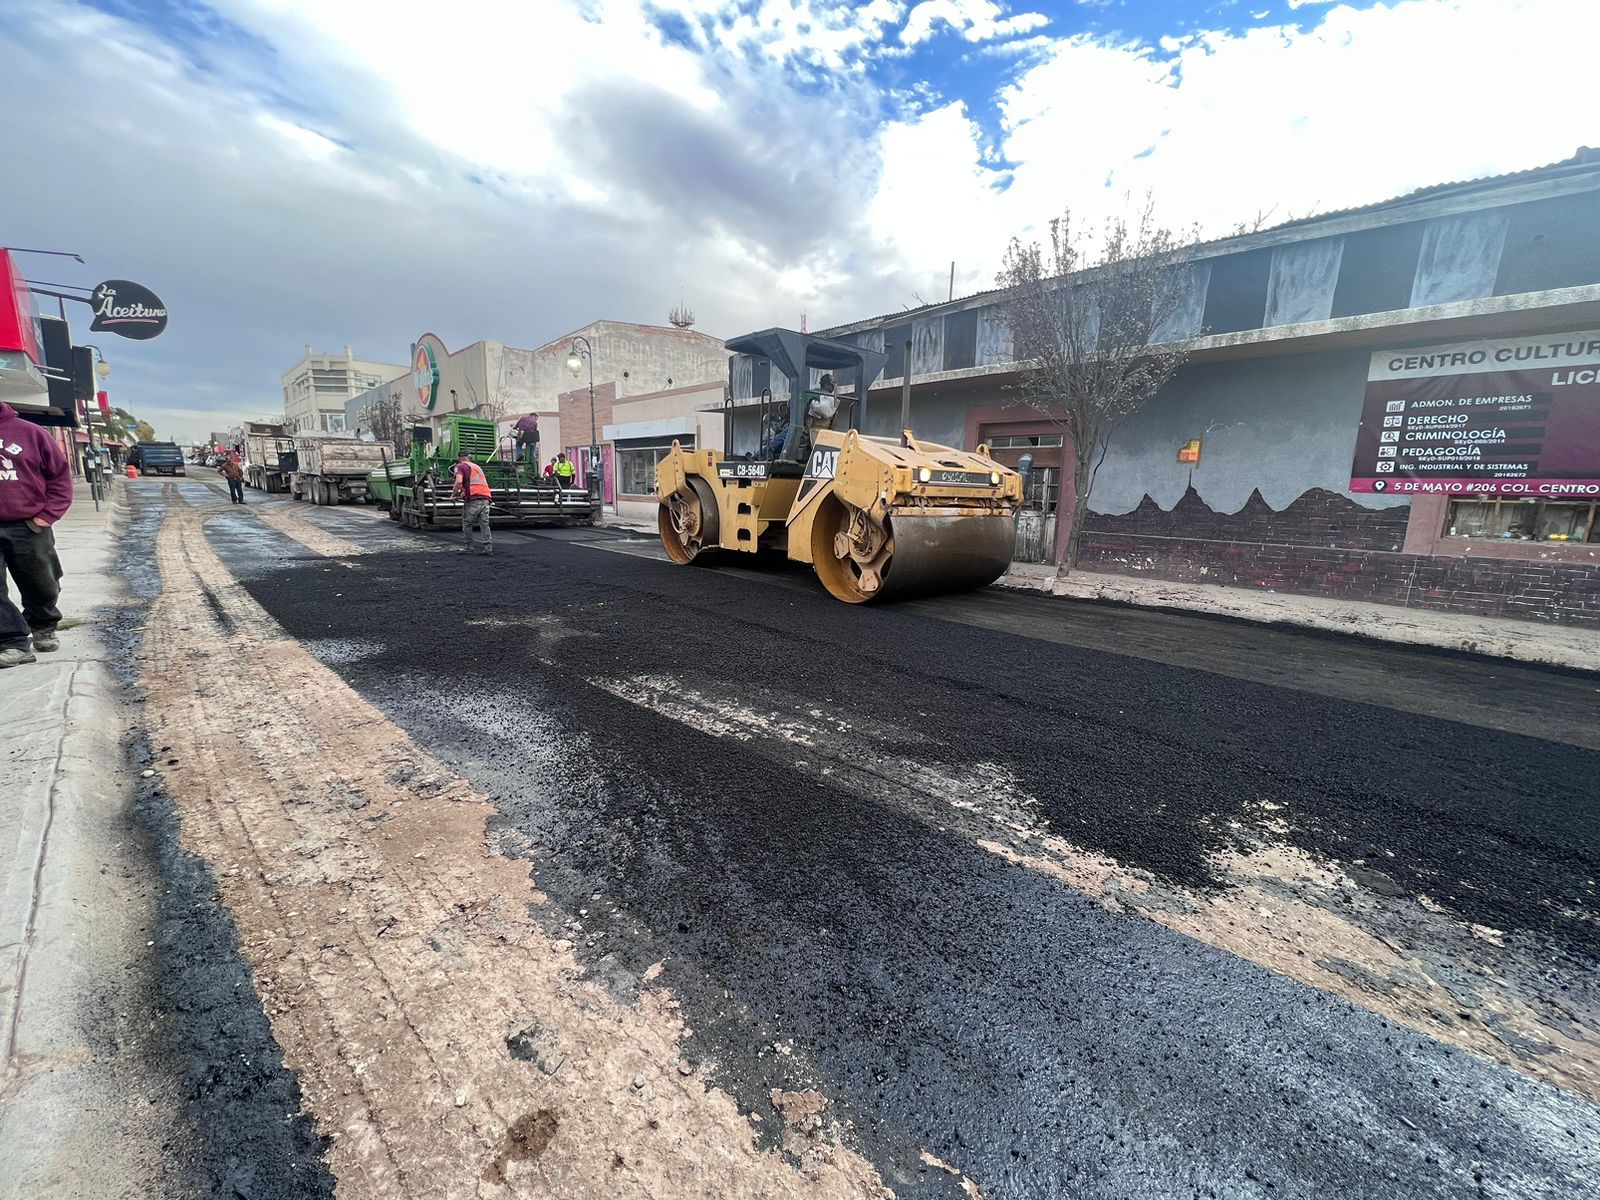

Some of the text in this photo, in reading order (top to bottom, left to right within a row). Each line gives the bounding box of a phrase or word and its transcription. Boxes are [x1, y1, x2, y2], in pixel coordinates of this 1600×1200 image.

[97, 284, 117, 298] La
[95, 296, 166, 317] Aceituna
[1388, 350, 1486, 371] CENTRO
[1411, 394, 1532, 408] ADMON. DE EMPRESAS
[1407, 414, 1468, 425] DERECHO
[1405, 427, 1506, 440] CRIMINOLOGÍA
[1402, 444, 1481, 456] PEDAGOGÍA
[812, 451, 840, 477] CAT
[1394, 482, 1599, 494] 5 DE MAYO #206 COL. CENTRO
